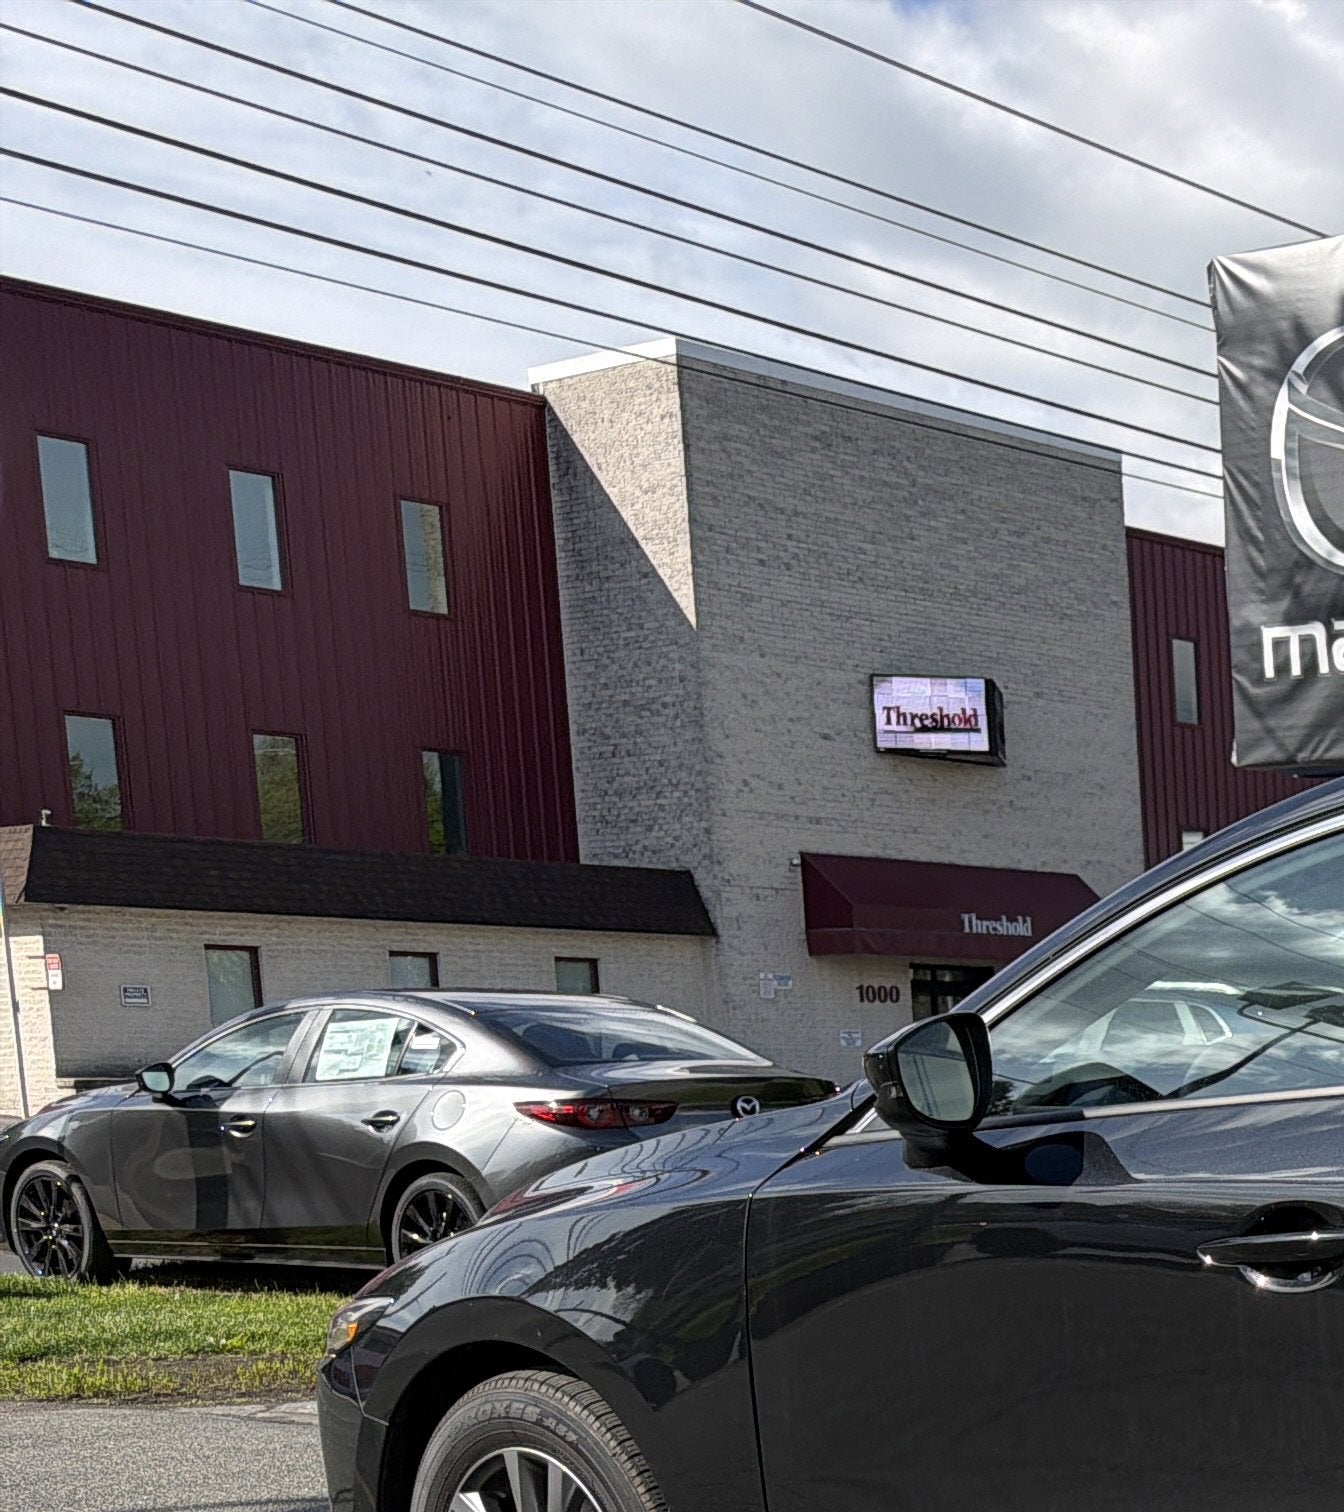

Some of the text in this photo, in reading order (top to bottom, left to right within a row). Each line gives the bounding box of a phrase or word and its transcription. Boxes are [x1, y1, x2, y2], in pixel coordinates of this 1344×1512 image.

[882, 705, 981, 729] Threshold
[961, 913, 1033, 937] Threshold
[855, 984, 900, 1004] 1000
